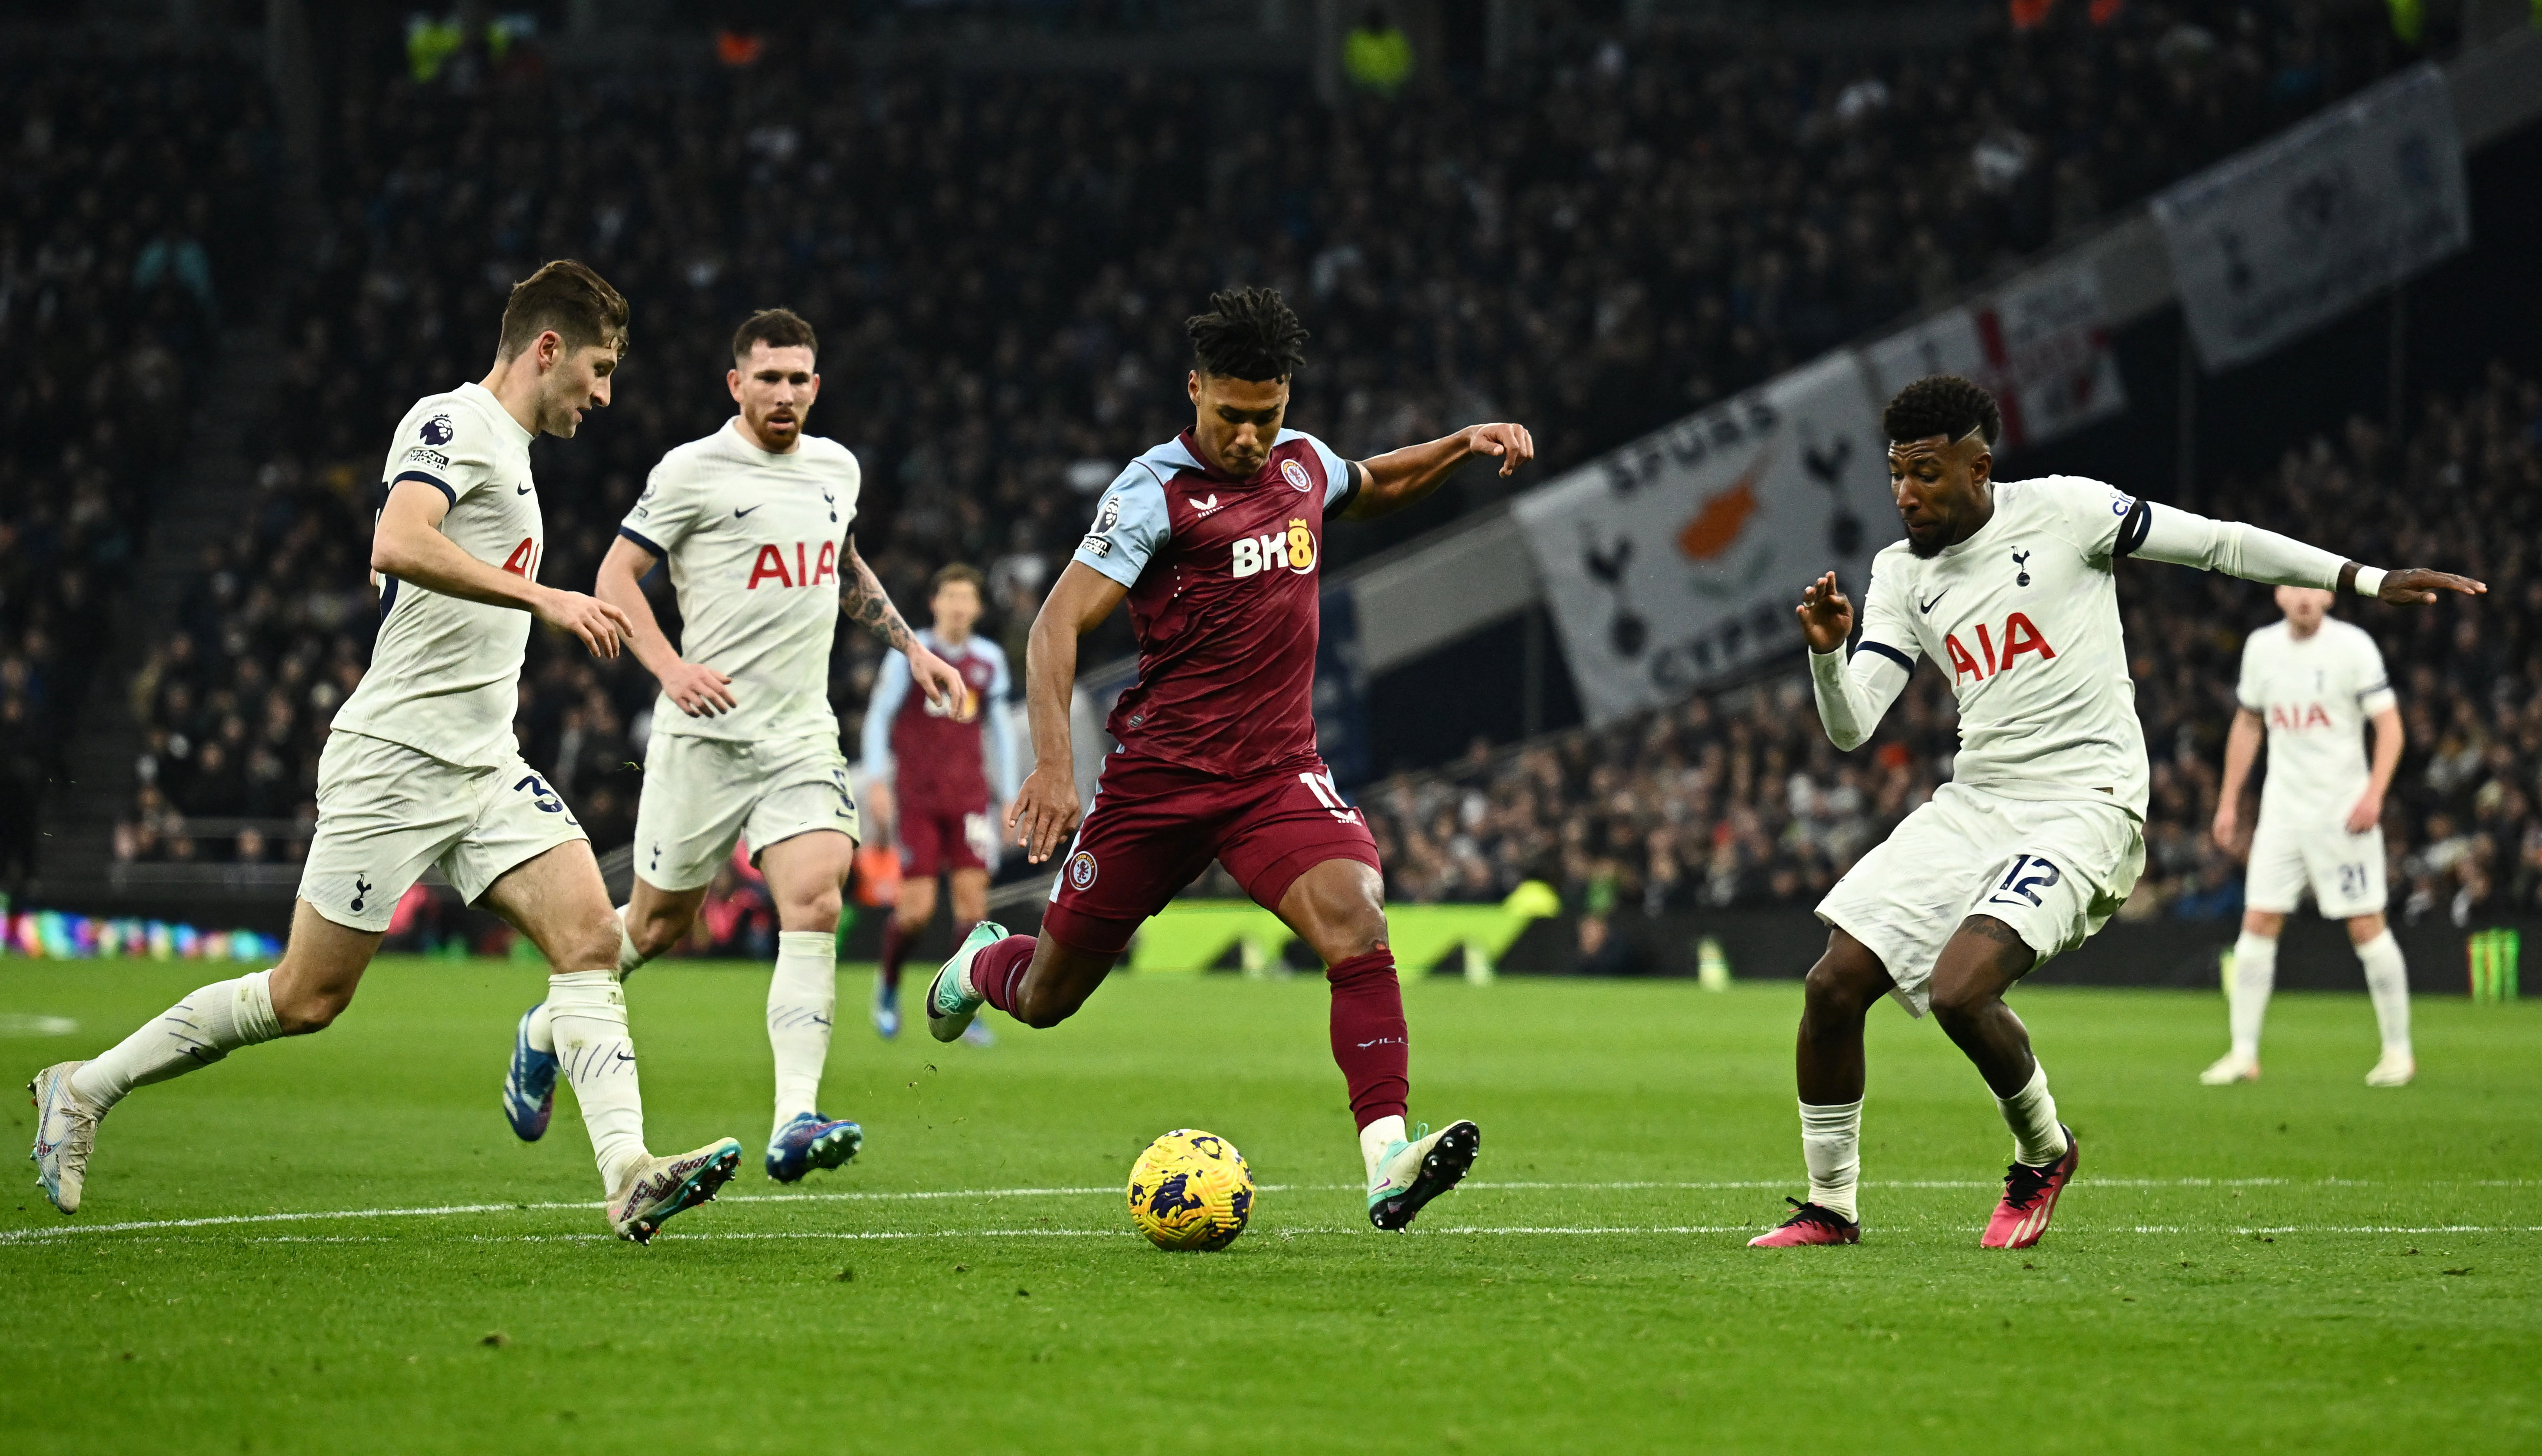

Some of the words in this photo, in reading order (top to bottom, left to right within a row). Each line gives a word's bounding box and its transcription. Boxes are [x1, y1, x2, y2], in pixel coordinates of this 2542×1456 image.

[415, 456, 446, 471] racism
[420, 450, 445, 463] room
[1606, 402, 1777, 497] SPURS
[1088, 537, 1107, 550] room
[1232, 526, 1314, 578] BK8
[747, 540, 835, 589] AIA
[1946, 612, 2057, 687] AIA
[2270, 701, 2332, 730] AIA
[1999, 854, 2060, 907] 12
[2337, 861, 2366, 892] 21
